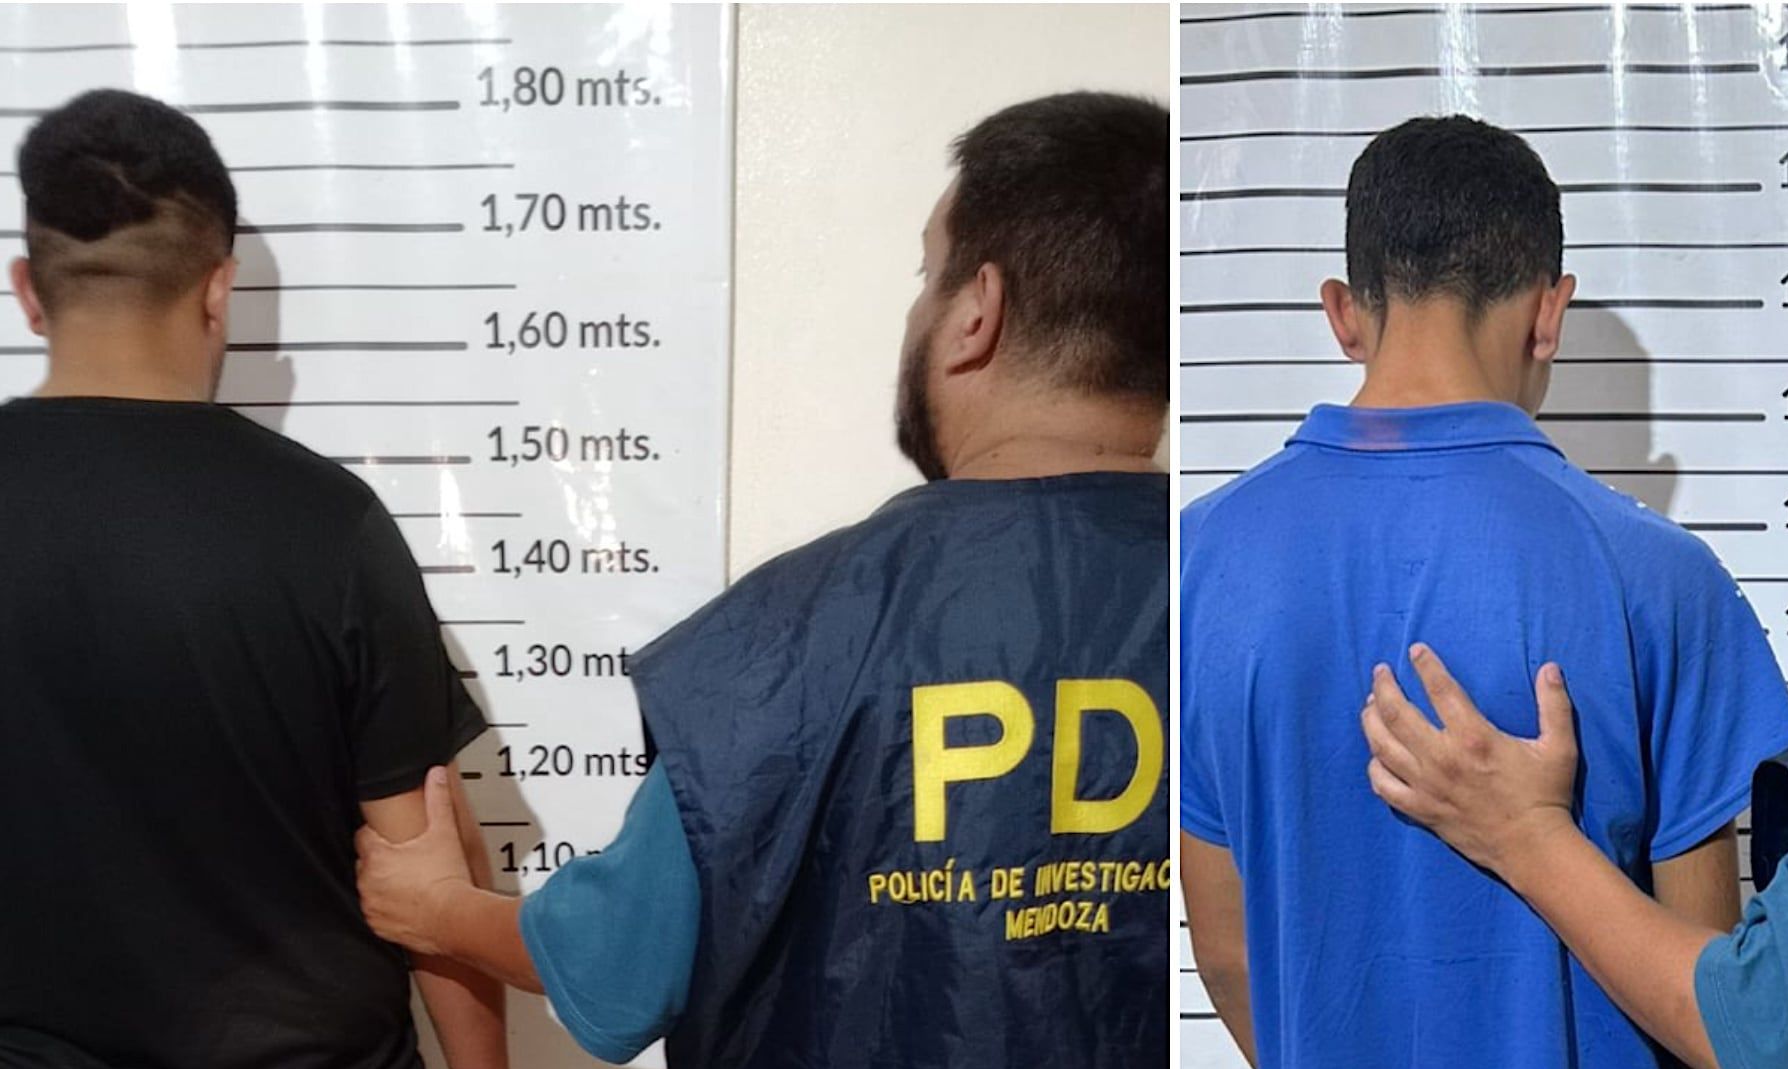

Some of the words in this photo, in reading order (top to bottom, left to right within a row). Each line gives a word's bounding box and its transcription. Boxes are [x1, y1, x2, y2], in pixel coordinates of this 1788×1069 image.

[476, 67, 564, 112] 1,80
[577, 70, 662, 105] mts.
[480, 194, 566, 237] 1,70
[578, 196, 661, 230] mts.
[484, 312, 567, 355] 1,60
[579, 314, 661, 348] mts.
[487, 426, 568, 466] 1,50
[580, 428, 660, 460] mts.
[491, 540, 569, 578] 1,40
[581, 542, 659, 573] mts.
[494, 645, 571, 681] 1,30
[583, 649, 630, 677] mt
[498, 745, 573, 780] 1,20
[585, 749, 650, 777] mts
[500, 842, 575, 878] 1,10
[868, 858, 976, 904] POLICÍA
[991, 867, 1025, 898] DE
[1005, 900, 1110, 940] MENDOZA
